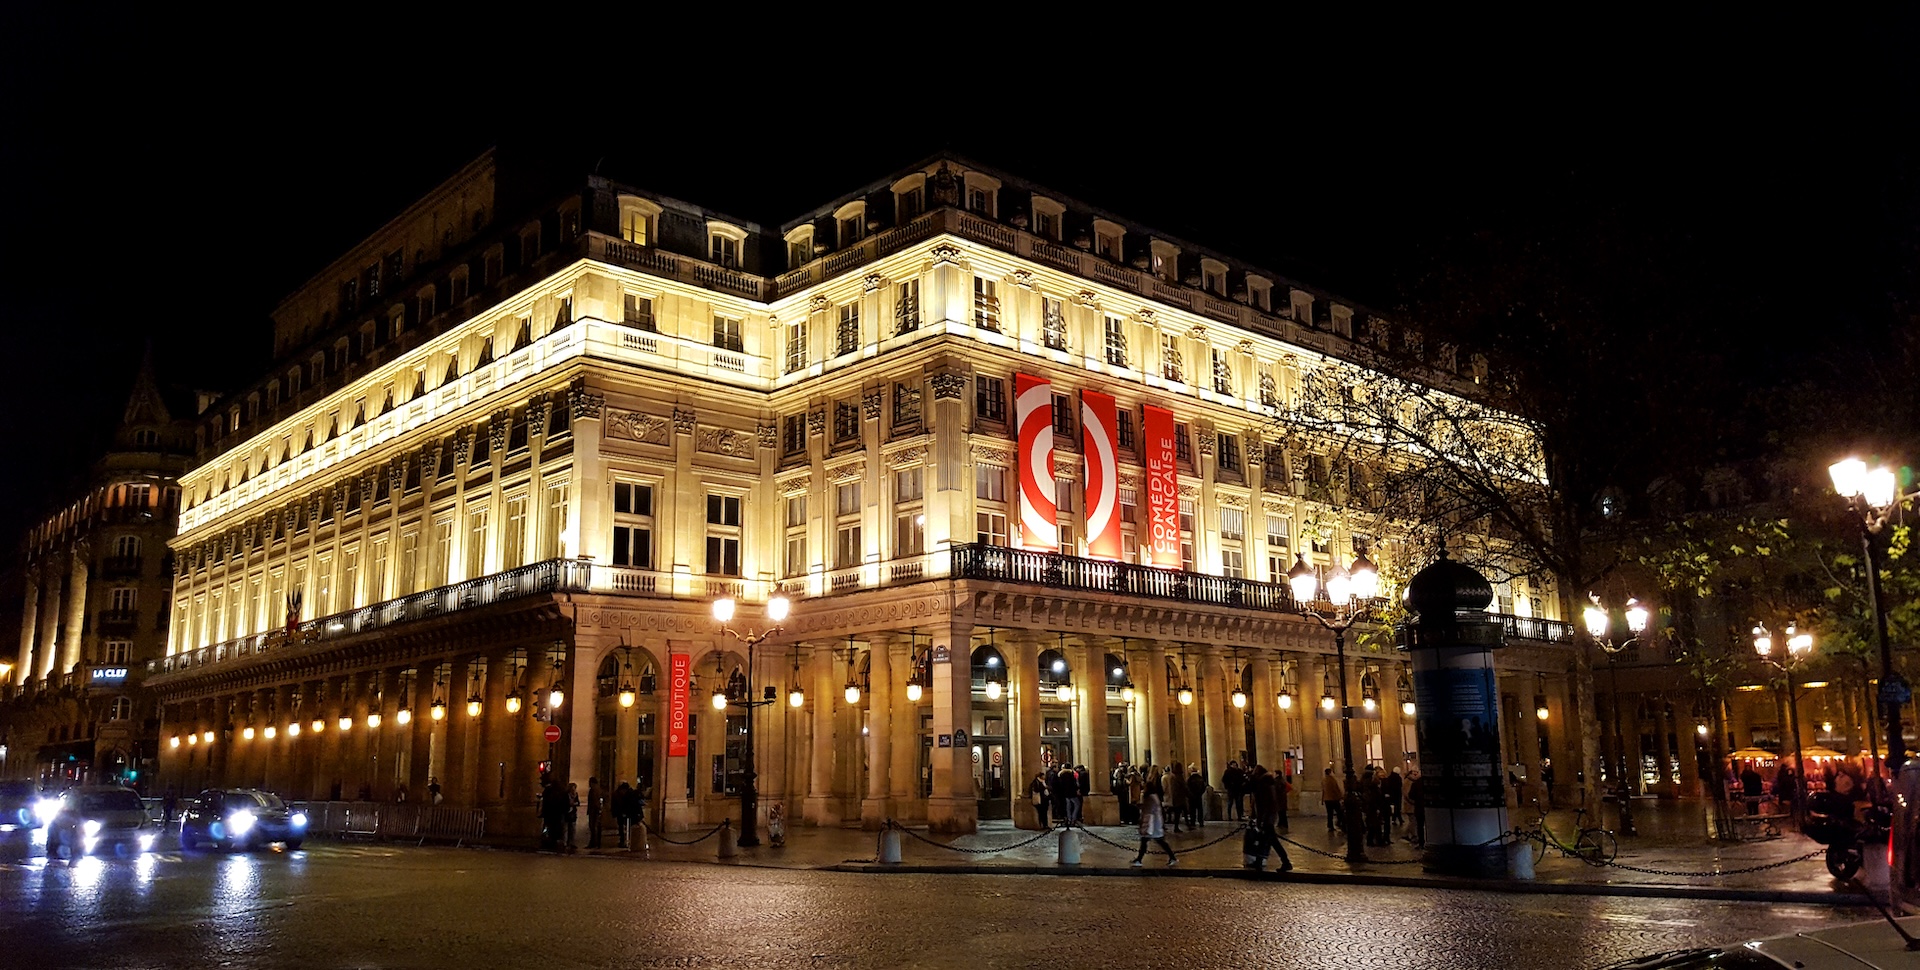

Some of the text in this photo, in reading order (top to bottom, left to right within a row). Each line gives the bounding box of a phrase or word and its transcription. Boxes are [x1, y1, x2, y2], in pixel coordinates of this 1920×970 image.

[1150, 458, 1165, 553] COMÉDIE
[1161, 437, 1178, 554] FRANÇAISE
[93, 668, 127, 678] LA CLEF
[673, 660, 686, 729] BOUTIQUE
